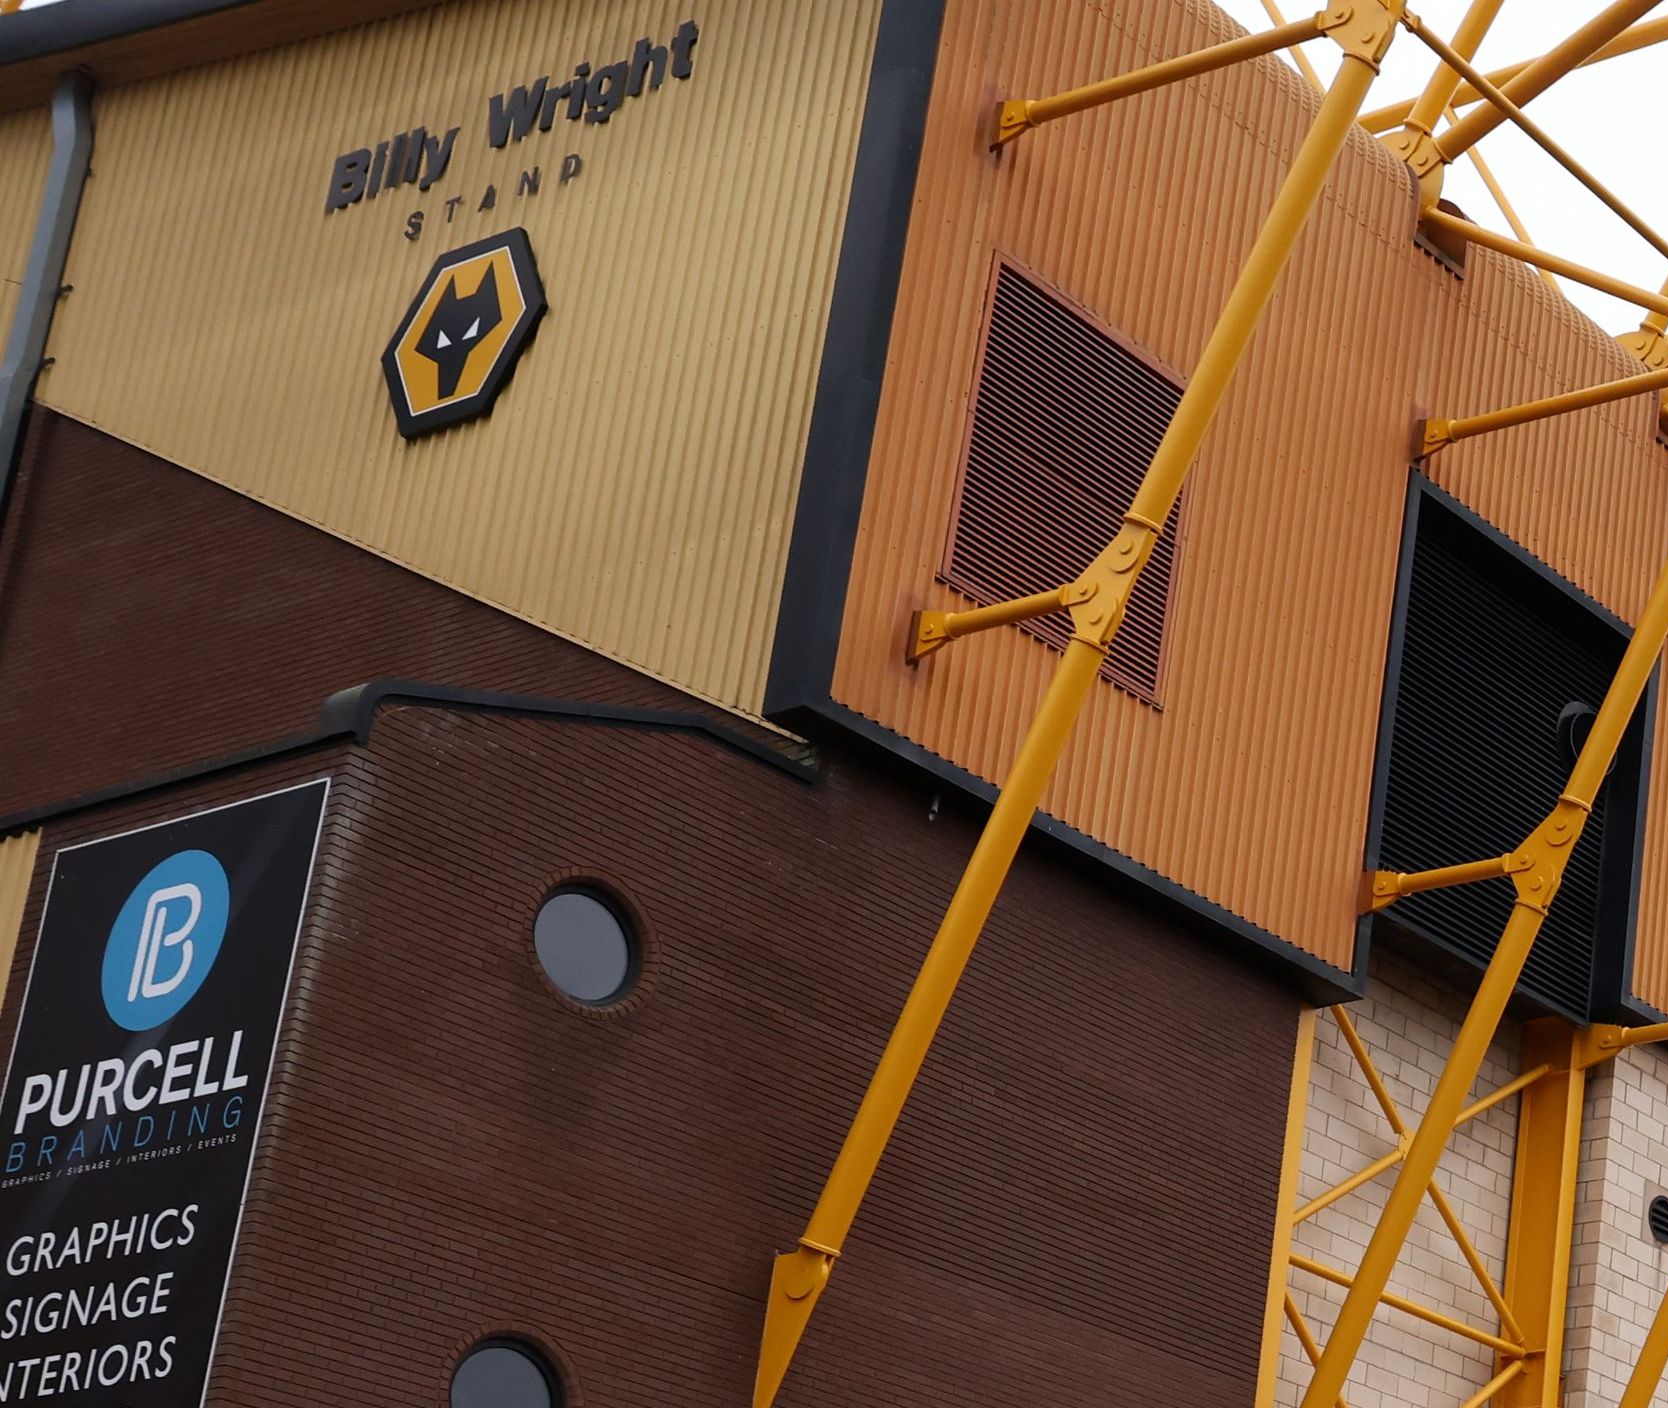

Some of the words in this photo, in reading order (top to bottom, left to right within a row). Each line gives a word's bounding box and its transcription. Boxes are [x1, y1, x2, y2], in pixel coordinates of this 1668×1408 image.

[325, 125, 461, 213] Billy
[488, 20, 700, 148] Wright
[404, 153, 584, 241] STAND
[14, 1030, 249, 1134] PURCELL
[1, 1172, 51, 1189] GRAPHICS
[66, 1159, 111, 1176] SIGNAGE
[126, 1145, 182, 1164] INTERIORS
[197, 1133, 238, 1150] EVENTS
[5, 1095, 244, 1173] BRANDING
[6, 1204, 199, 1276] GRAPHICS
[1, 1272, 174, 1340] SIGNAGE
